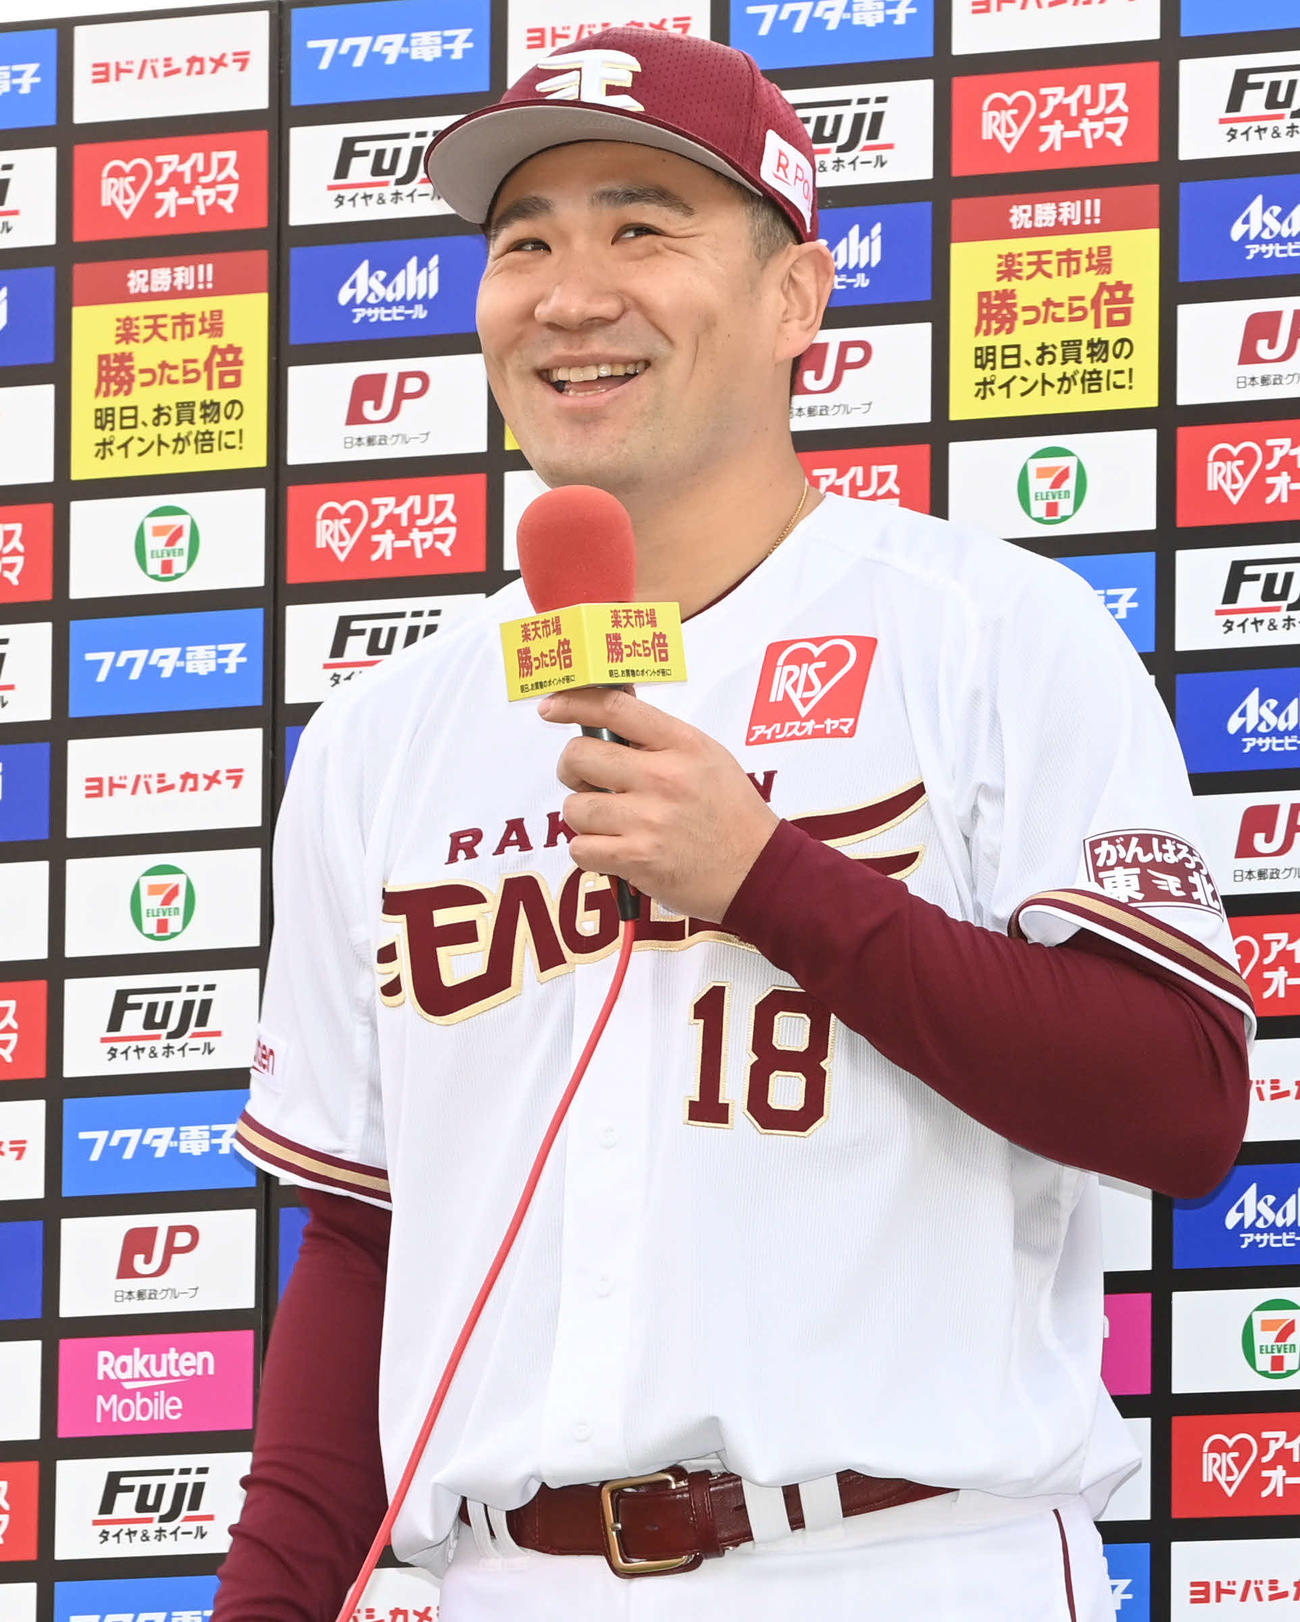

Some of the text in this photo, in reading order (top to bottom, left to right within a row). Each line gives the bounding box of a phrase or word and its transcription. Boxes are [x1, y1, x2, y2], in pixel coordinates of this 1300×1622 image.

[306, 28, 474, 71] フクダ電子
[91, 51, 251, 84] ヨドバシカメラ
[1039, 82, 1128, 118] アイリス
[1225, 64, 1300, 119] Fu
[982, 110, 1018, 140] IRIS
[1039, 117, 1128, 153] オーヤマ
[154, 150, 239, 186] アイリス
[333, 129, 442, 186] Fuj
[101, 177, 137, 207] IRIS
[154, 184, 239, 219] オーヤマ
[1009, 199, 1101, 230] 祝勝利!!
[127, 263, 214, 294] 祝勝利!!
[337, 254, 440, 307] Asahi
[996, 246, 1113, 282] 楽天市場
[115, 309, 225, 345] 楽天市場
[352, 303, 428, 324] アサヒビール
[974, 281, 1134, 338] 勝ったら倍
[94, 344, 244, 399] 勝ったら倍
[795, 340, 873, 395] JP
[974, 337, 1134, 372] 明日、お買物の
[345, 370, 430, 426] JP
[974, 368, 1134, 401] ポイントが倍に!
[94, 399, 244, 432] 明日、お買物の
[94, 428, 244, 461] ポイントが倍に!
[344, 431, 431, 449] 日本郵政グループ
[1207, 460, 1245, 491] IRIS
[371, 493, 457, 528] アイリス
[316, 517, 351, 549] IRIS
[371, 526, 457, 561] オーヤマ
[1221, 557, 1300, 612] Fu
[521, 616, 562, 643] 楽天市場
[610, 608, 657, 629] 楽天市場
[84, 642, 247, 683] フクダ電子
[517, 638, 573, 679] 勝ったら倍
[606, 632, 669, 664] 勝ったら倍
[770, 661, 827, 703] IRIS
[750, 718, 855, 742] アイリスオーヤマ
[1241, 735, 1300, 753] アサヒビ
[84, 768, 245, 799] ヨドバシカメラ
[1094, 836, 1208, 875] がんばろう
[106, 984, 217, 1040] Fuji
[106, 1041, 216, 1062] タイヤ&ホイール
[683, 981, 837, 1138] 18
[78, 1123, 238, 1161] フクダ電子
[1225, 1183, 1300, 1230] Asa
[116, 1225, 200, 1280] JP
[114, 1286, 200, 1303] 日本郵政グループ
[97, 1348, 215, 1382] Rakuten
[96, 1392, 183, 1424] Mobile
[1202, 1452, 1240, 1483] IRIS
[97, 1467, 209, 1523] Fuji
[97, 1526, 208, 1544] タイヤ&ホイール
